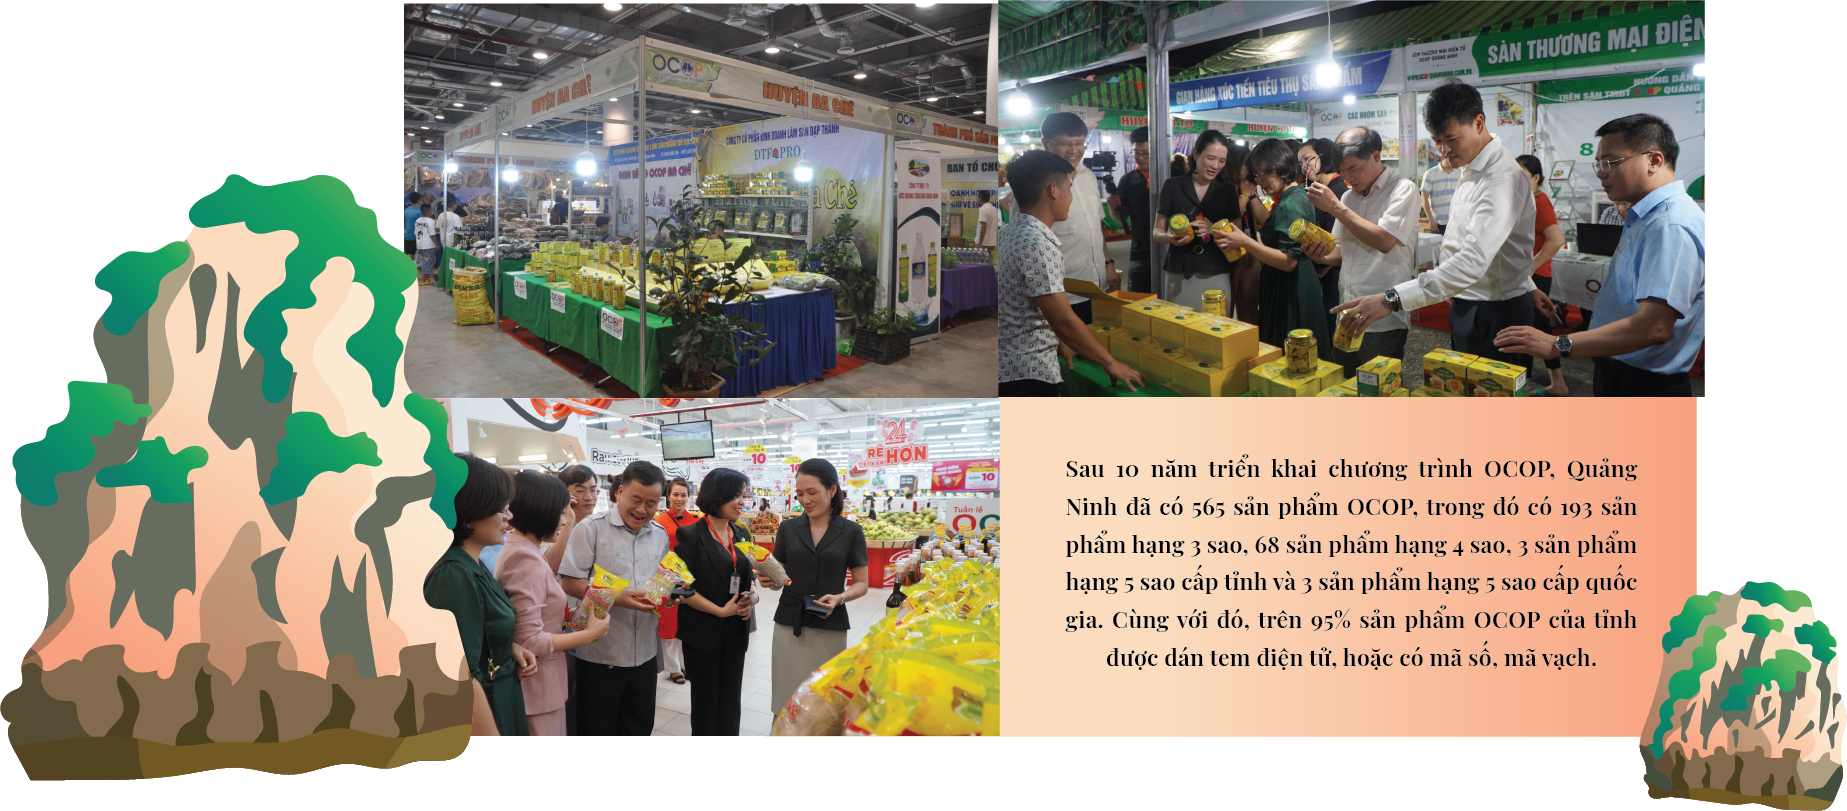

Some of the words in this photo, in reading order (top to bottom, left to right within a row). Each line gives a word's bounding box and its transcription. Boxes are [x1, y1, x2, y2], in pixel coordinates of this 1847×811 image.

[1487, 39, 1522, 65] SÀN
[1526, 31, 1601, 60] THƯƠNG
[1607, 24, 1649, 53] MẠI
[557, 86, 570, 105] BA
[762, 81, 809, 108] HUYỆN
[811, 92, 830, 112] BA
[1176, 89, 1193, 105] GIAN
[1194, 86, 1216, 103] HÀNG
[1217, 81, 1234, 101] XÚC
[1235, 79, 1255, 99] TIẾN
[1256, 76, 1278, 96] TIÊU
[1280, 75, 1299, 97] THỤ
[1558, 91, 1580, 101] TRÊN
[1583, 90, 1602, 100] SÀN
[1633, 87, 1662, 96] OCOP
[771, 129, 787, 141] DOANH
[754, 147, 773, 161] DTF
[779, 144, 801, 160] PRO
[1579, 142, 1594, 156] 8
[649, 167, 667, 178] OCOP
[667, 166, 677, 177] BA
[947, 163, 965, 173] BAN
[602, 312, 623, 328] OCOP
[751, 452, 767, 465] 10
[885, 444, 928, 465] HƠN
[981, 472, 996, 482] 10
